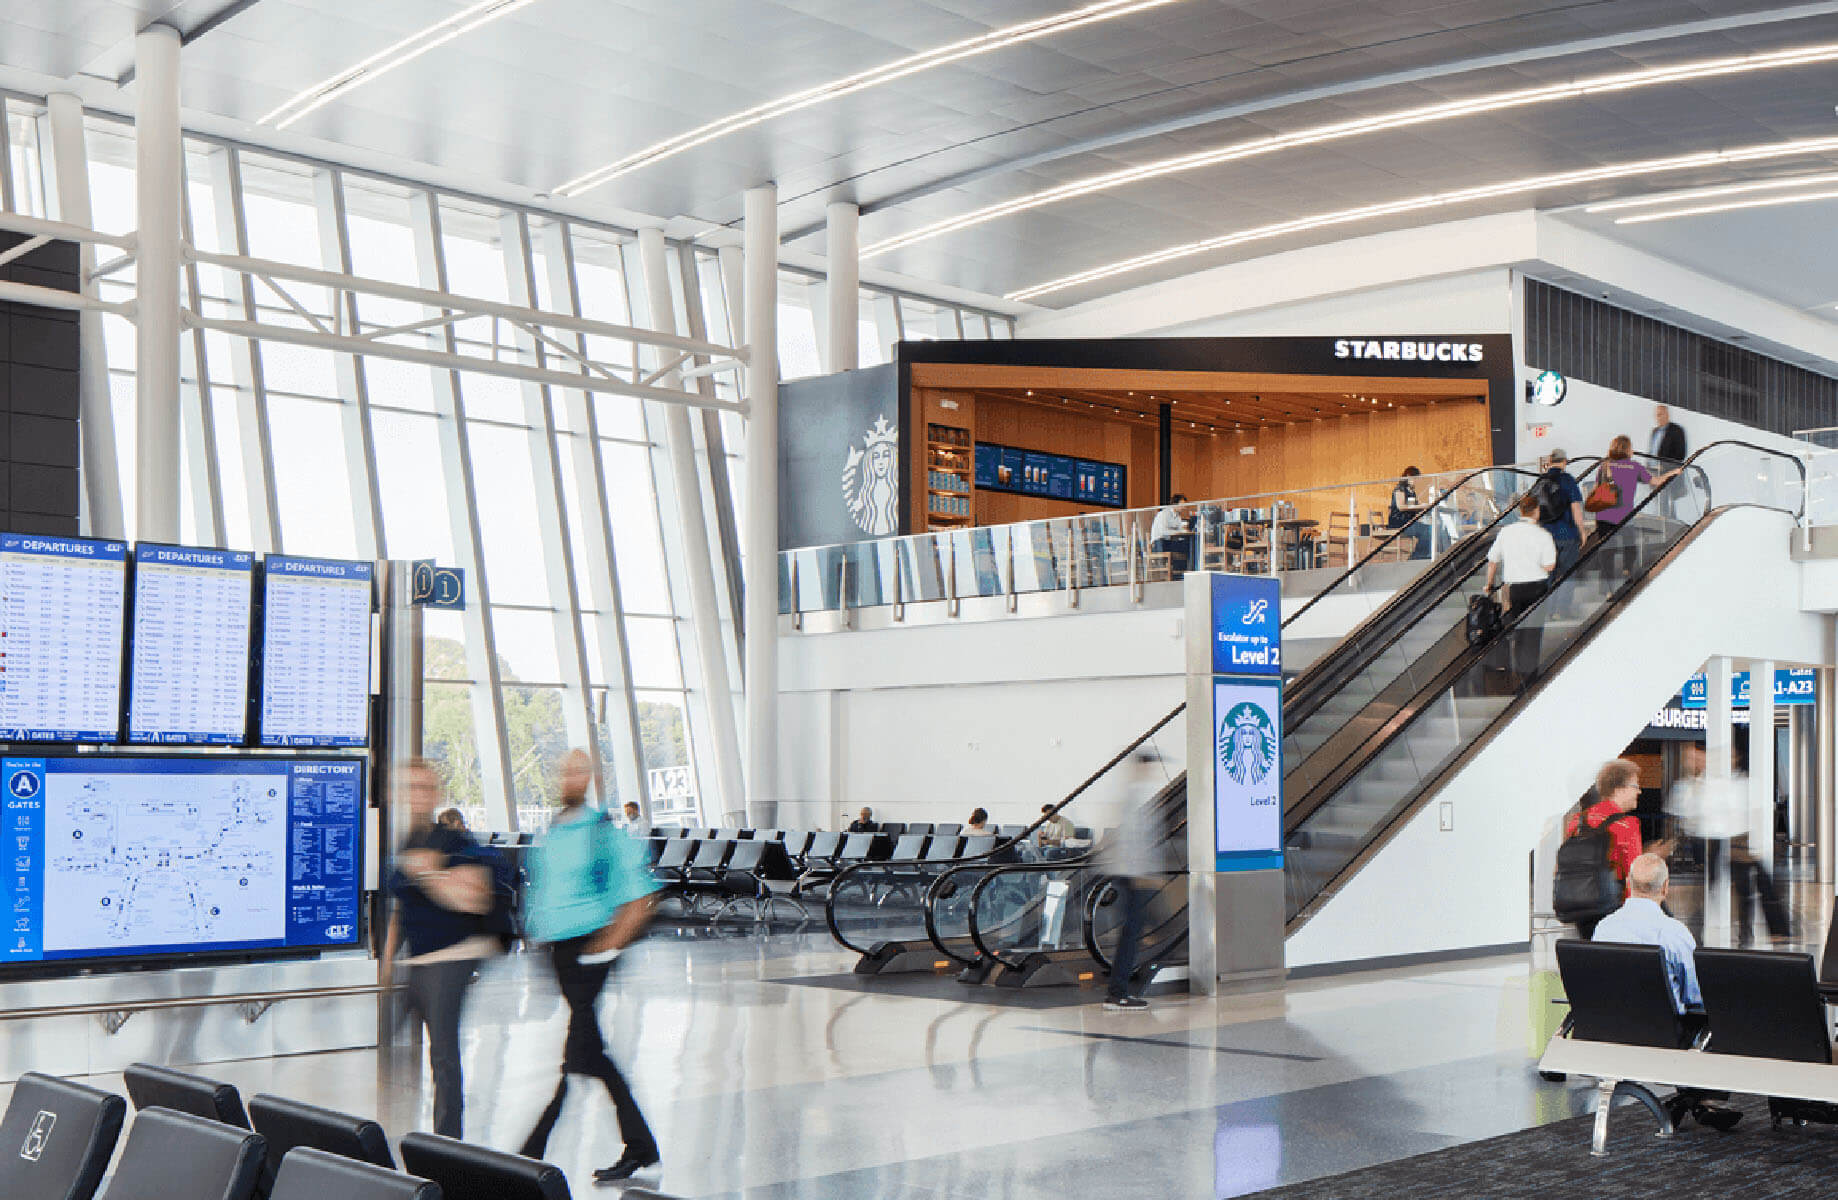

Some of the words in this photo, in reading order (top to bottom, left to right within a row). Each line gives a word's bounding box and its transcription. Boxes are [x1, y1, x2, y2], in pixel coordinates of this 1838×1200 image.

[1334, 339, 1483, 362] STARBUCKS
[23, 540, 95, 555] DEPARTURES
[158, 551, 224, 564] DEPARTURES
[285, 562, 346, 576] DEPARTURES
[1218, 631, 1248, 642] Escalator
[1250, 636, 1260, 646] up
[1260, 636, 1268, 644] to
[1232, 645, 1269, 665] Level
[1271, 647, 1280, 666] 2
[1774, 680, 1813, 695] 1-A23
[294, 765, 355, 774] DIRECTORY
[16, 775, 32, 793] A
[8, 801, 40, 809] GATES
[1250, 795, 1270, 806] Level
[1271, 795, 1277, 806] 2
